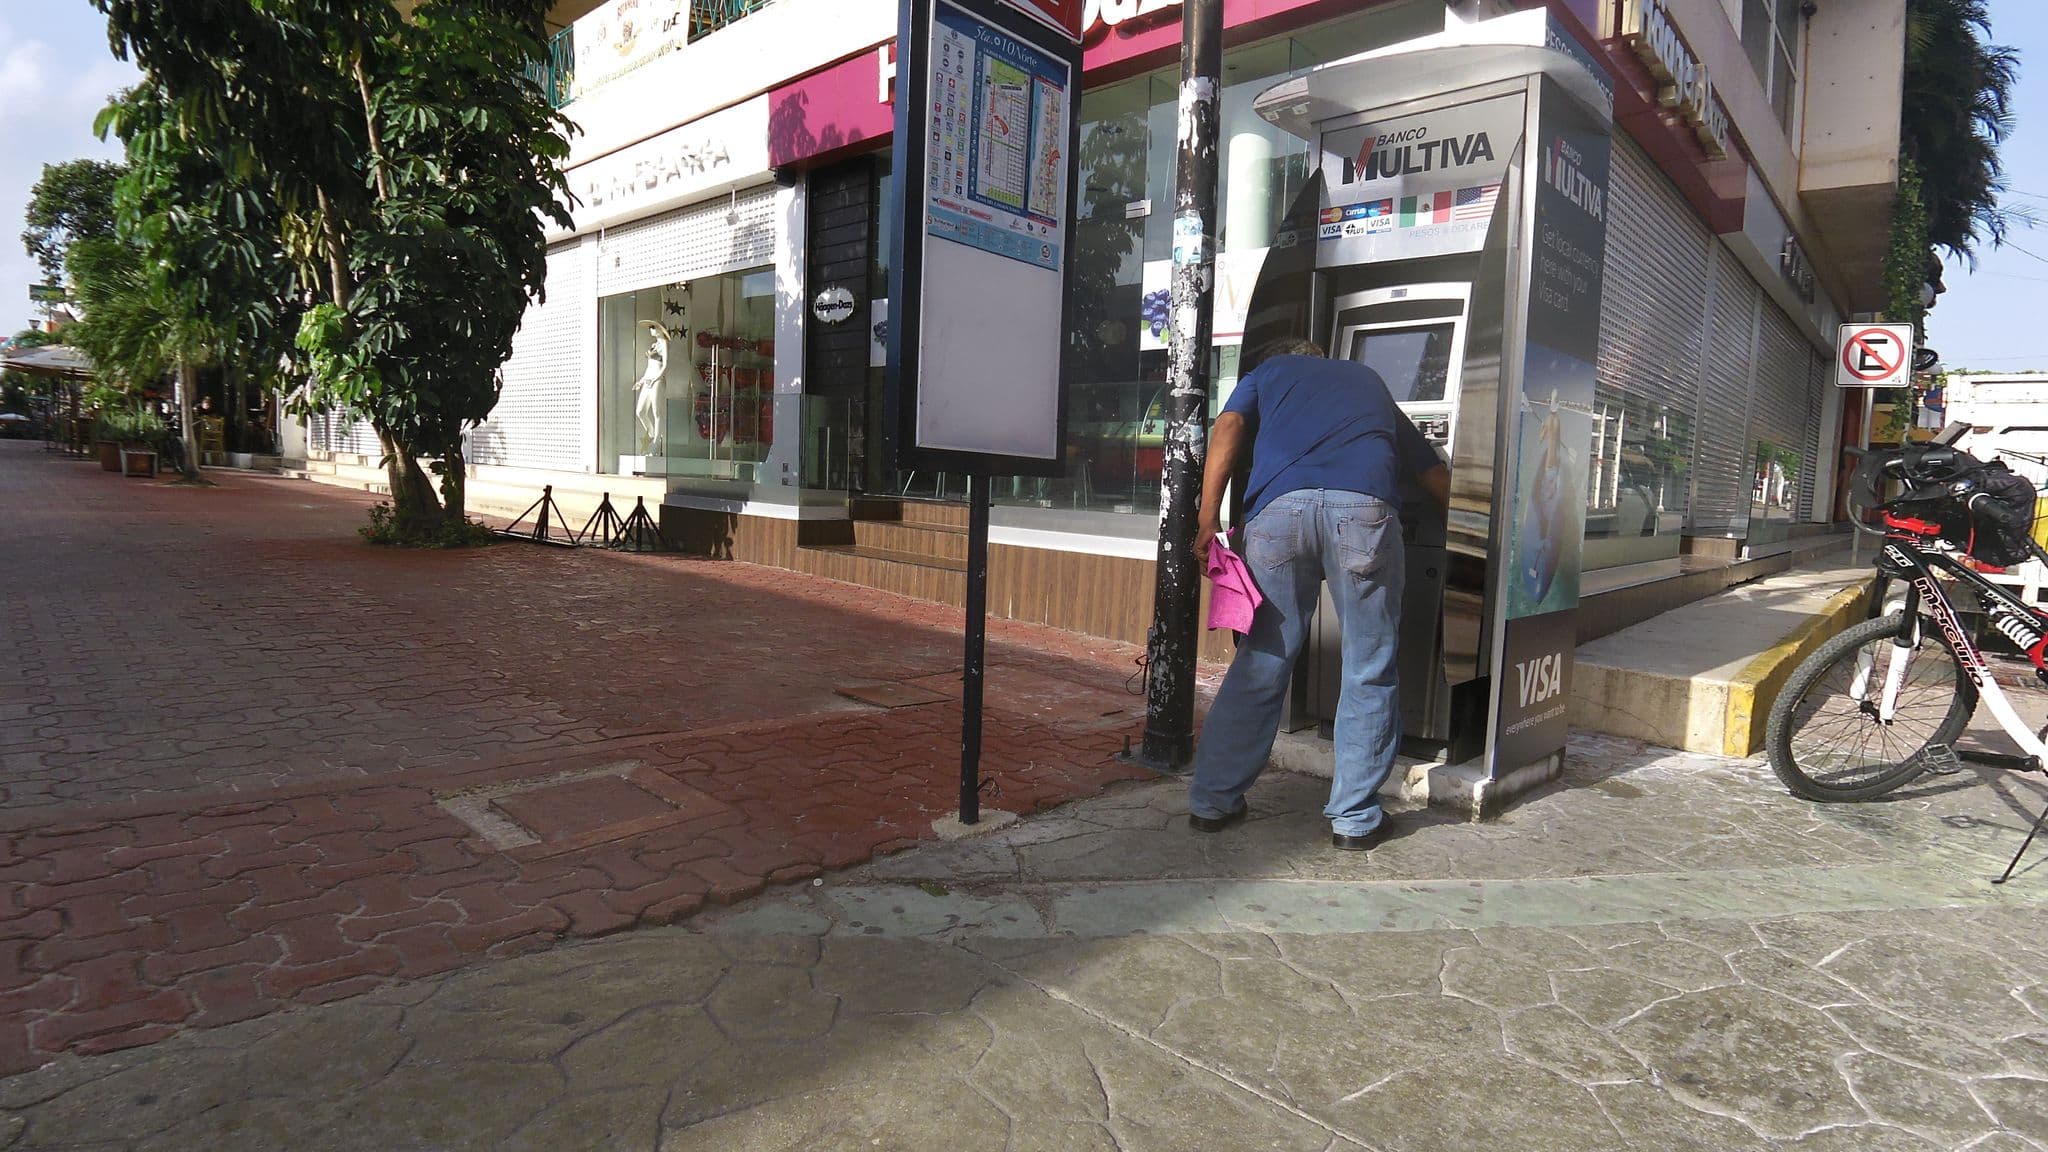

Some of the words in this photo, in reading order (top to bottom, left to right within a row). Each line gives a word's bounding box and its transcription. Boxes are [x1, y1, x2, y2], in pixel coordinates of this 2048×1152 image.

[1002, 39, 1015, 56] 10
[1376, 127, 1427, 147] BANCO
[1342, 132, 1495, 186] MULTIVA
[1561, 141, 1582, 166] BANCO
[1545, 136, 1602, 222] MULTIVA
[1322, 225, 1341, 235] VISA
[1350, 227, 1364, 236] PLUS
[1370, 217, 1391, 227] VISA
[1515, 652, 1562, 708] VISA
